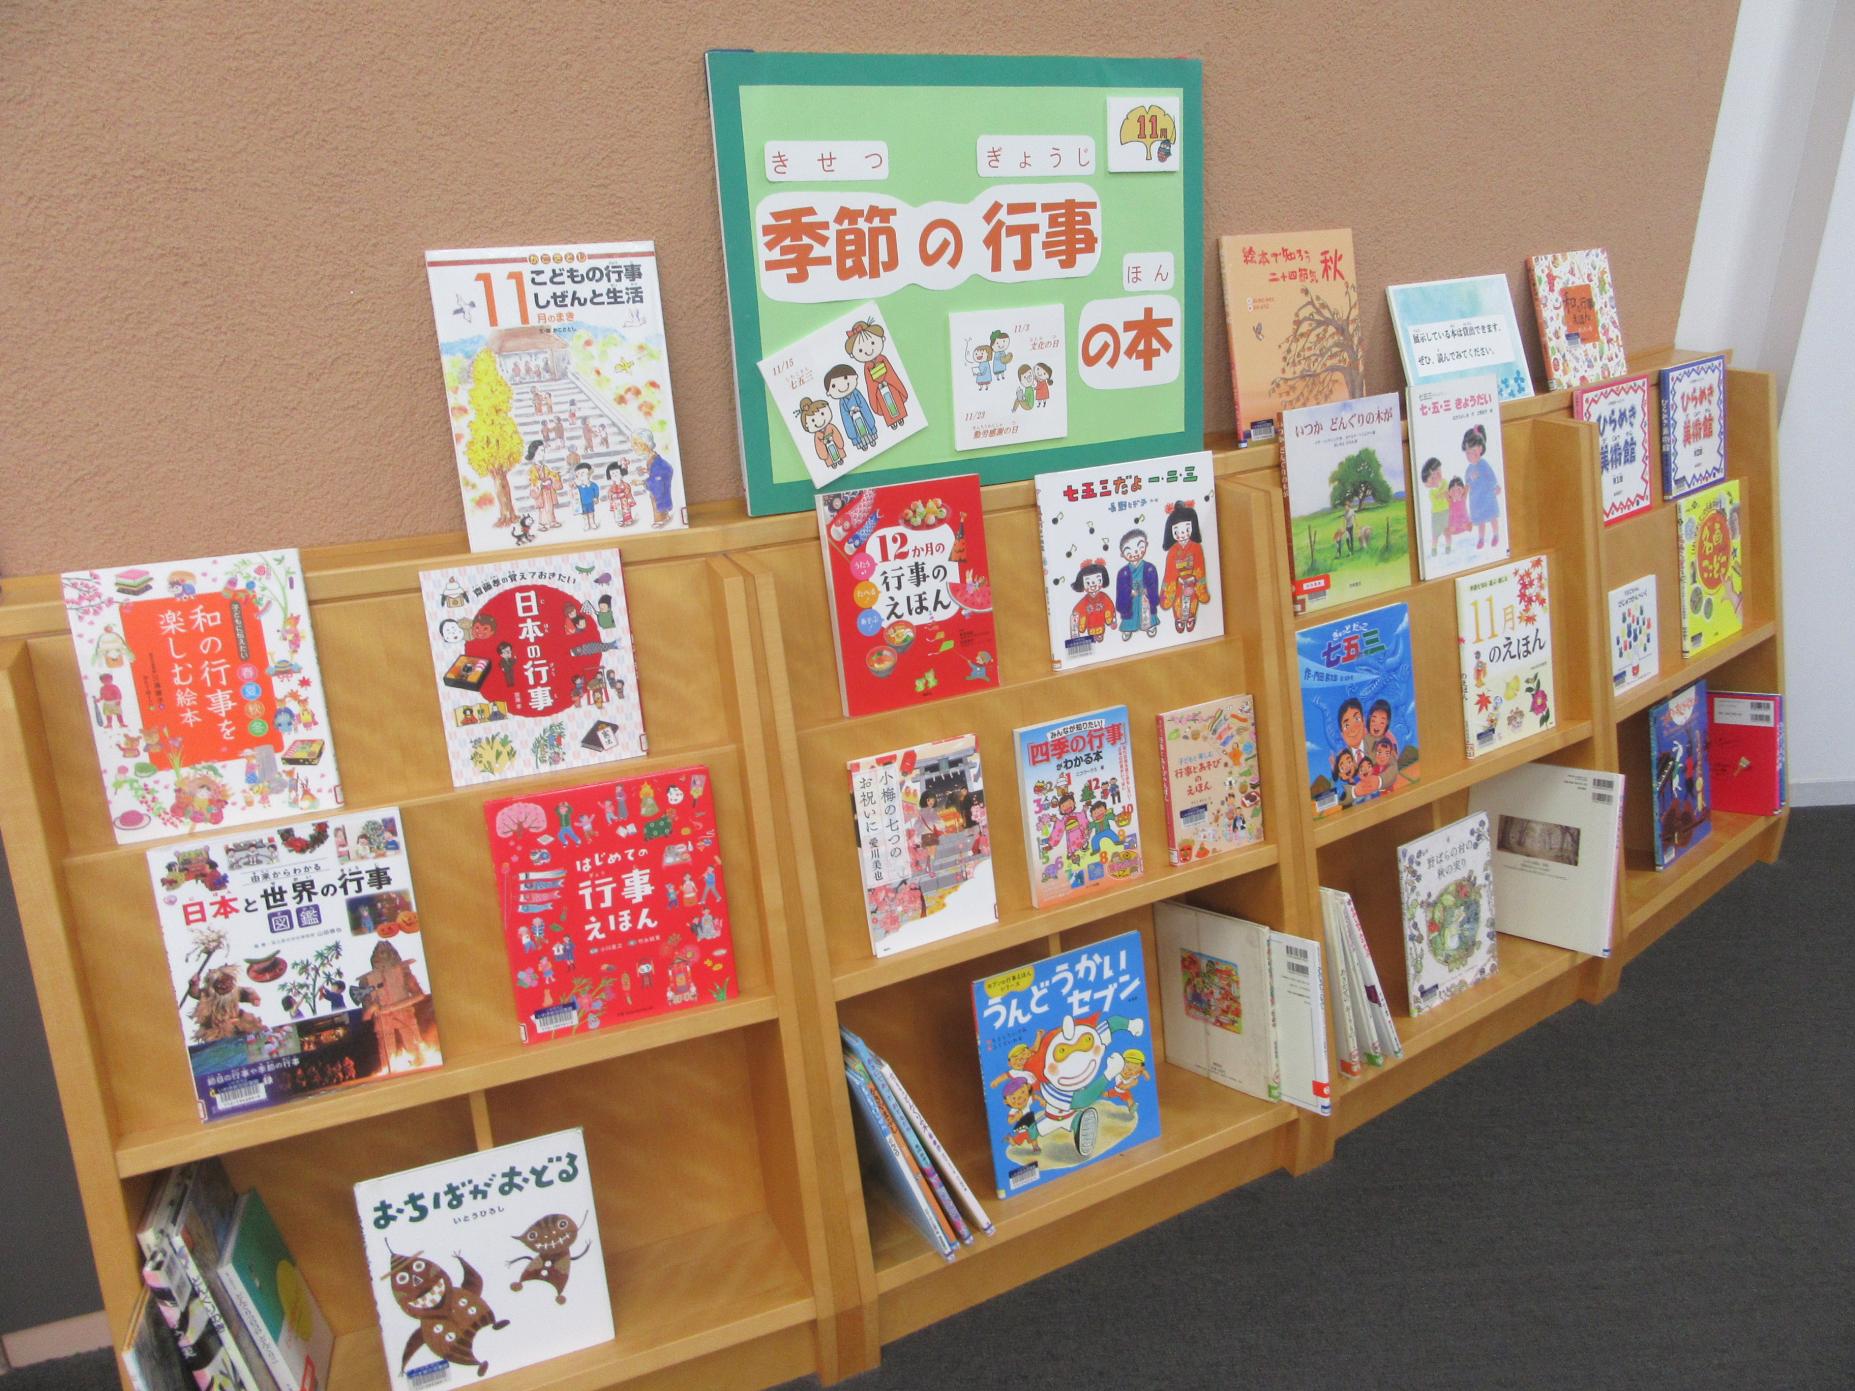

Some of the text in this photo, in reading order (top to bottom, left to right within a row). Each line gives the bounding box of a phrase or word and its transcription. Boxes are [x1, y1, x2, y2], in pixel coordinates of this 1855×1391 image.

[1137, 115, 1168, 139] 11月
[770, 150, 884, 175] きせつ
[986, 145, 1091, 169] ぎょうじ
[761, 198, 1099, 284] 季節の行事
[530, 263, 643, 287] こどもの行事
[1127, 264, 1170, 284] ほん
[1320, 248, 1345, 282] 秋
[474, 271, 530, 328] 11
[533, 285, 644, 310] しぜんと生活
[1080, 307, 1174, 372] の本
[1294, 421, 1324, 438] いつか
[1062, 474, 1143, 502] 七五三だよ
[877, 532, 946, 563] 12か月の
[879, 561, 948, 592] 行事の
[885, 588, 952, 620] えほん
[1470, 595, 1515, 644] 11月
[514, 589, 554, 711] 日本の行事
[1321, 628, 1387, 669] 七五三
[1488, 627, 1546, 663] のえほん
[158, 609, 202, 728] 楽しむ絵本
[189, 603, 238, 741] 和の行事を
[1055, 750, 1104, 771] がわかる本
[858, 776, 879, 833] お祝いに
[880, 770, 903, 859] 小梅の七つの
[575, 848, 649, 872] はじめての
[181, 865, 393, 926] 日本と世界の行事
[578, 868, 655, 910] 行事
[271, 906, 320, 933] 図鑑
[584, 908, 659, 942] えほん
[983, 949, 1127, 1030] うんどうかい
[1066, 973, 1142, 1017] セブン
[373, 1151, 579, 1230] おちばがおどる
